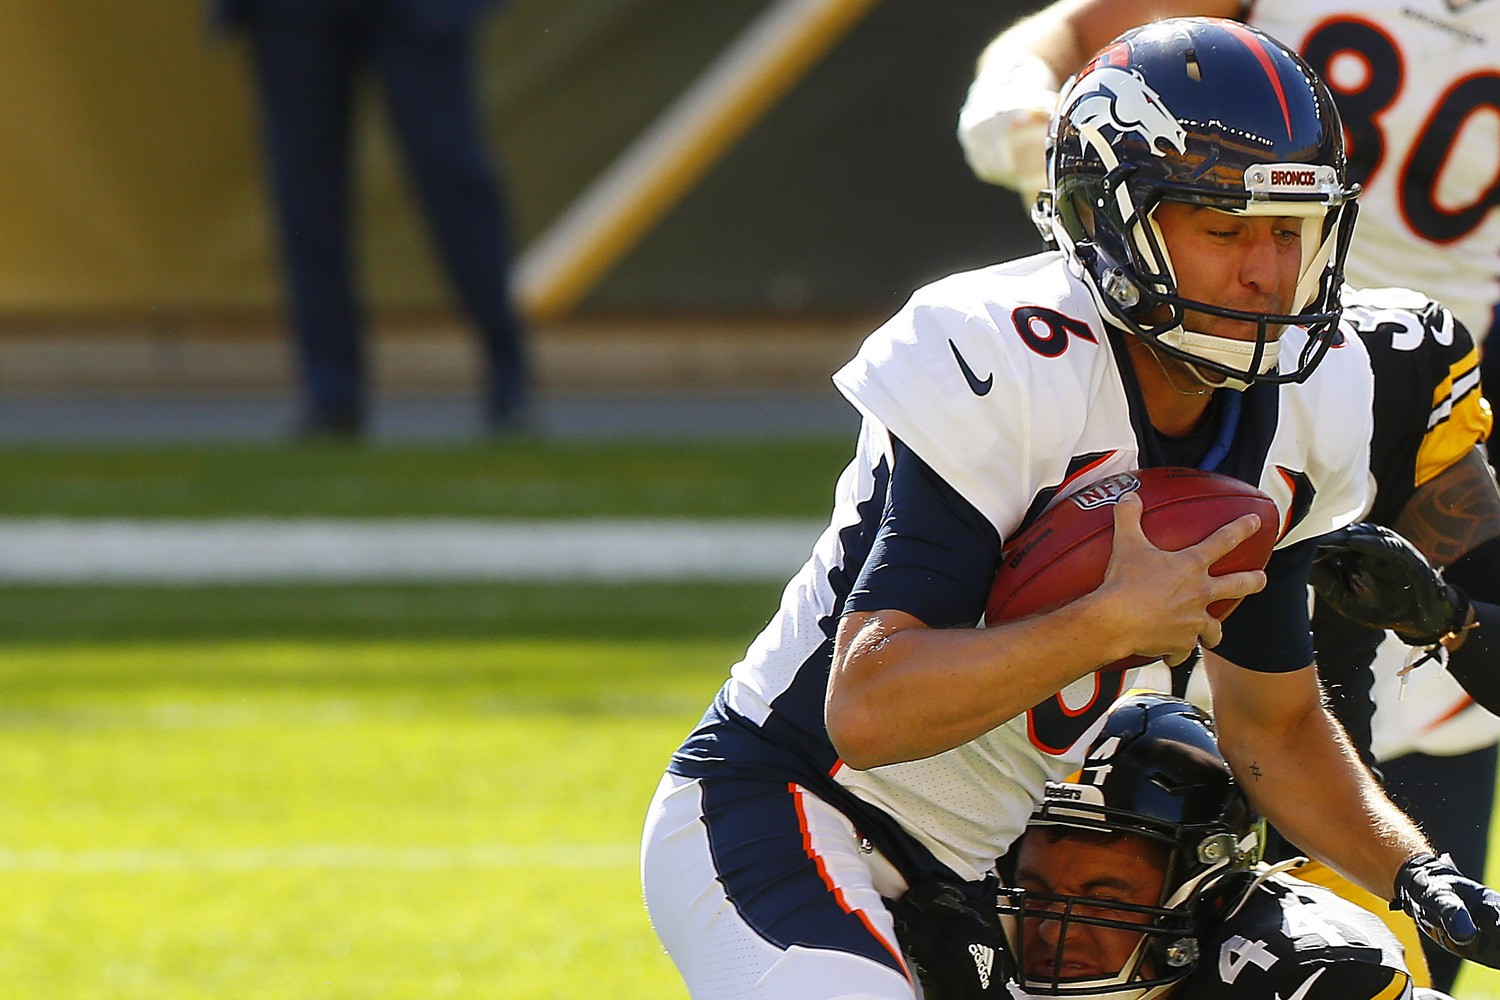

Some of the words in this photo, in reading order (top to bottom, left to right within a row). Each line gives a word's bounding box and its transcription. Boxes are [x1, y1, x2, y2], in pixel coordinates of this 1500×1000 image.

[1271, 171, 1316, 186] BRONCOS
[1010, 306, 1099, 358] 6
[1080, 474, 1134, 505] NFL
